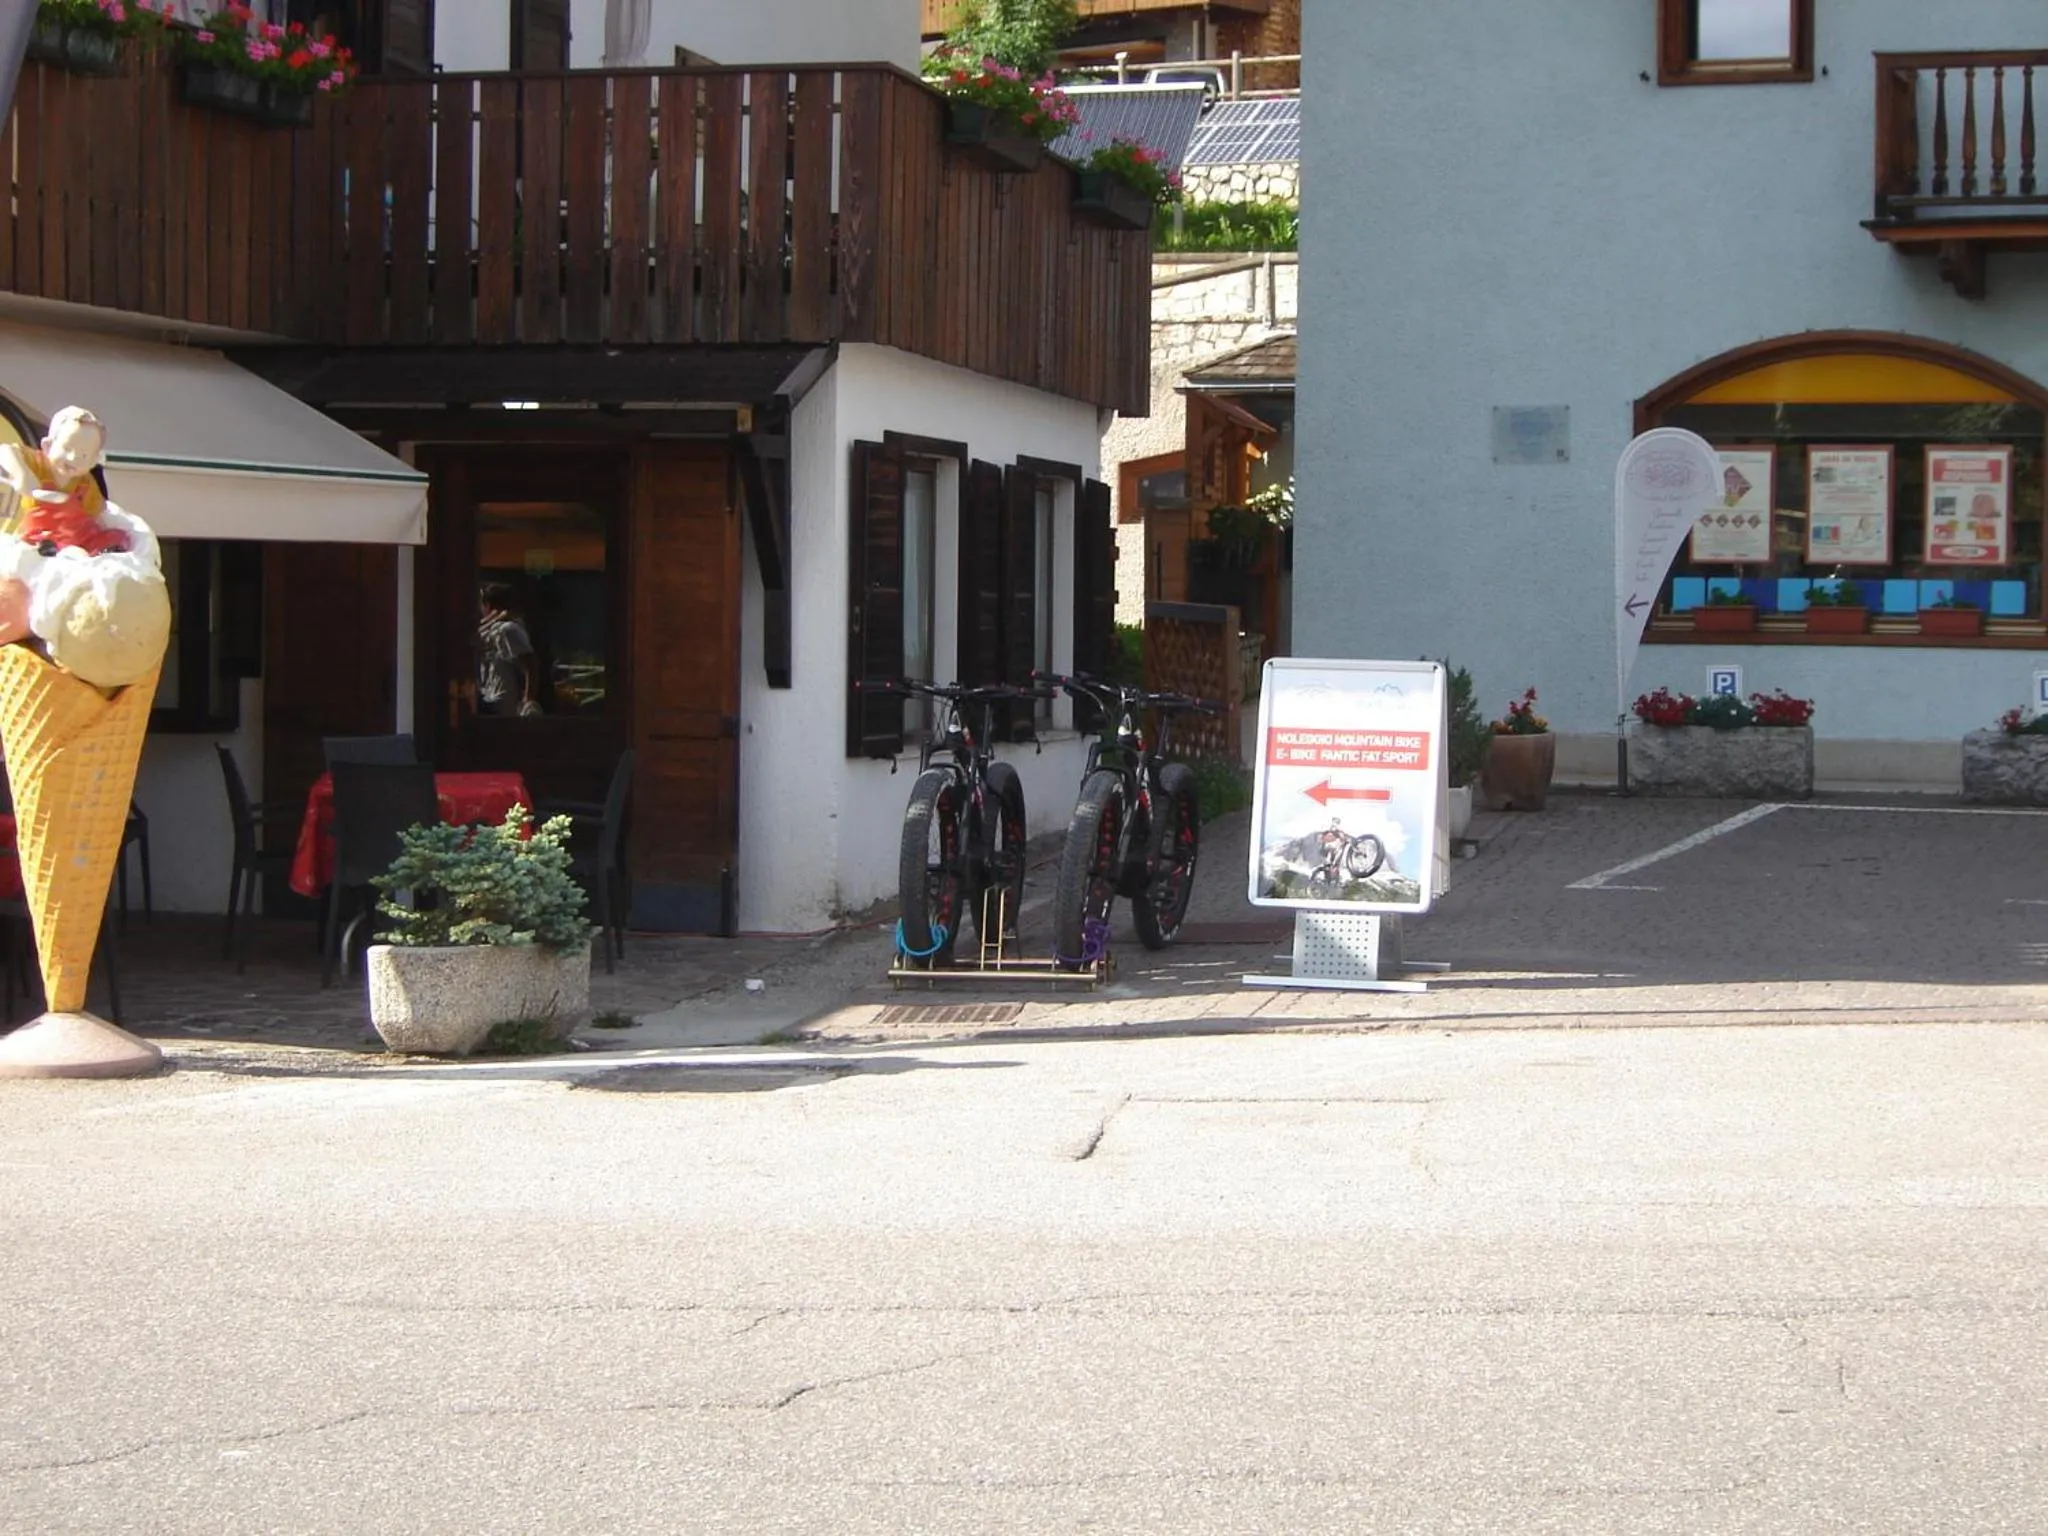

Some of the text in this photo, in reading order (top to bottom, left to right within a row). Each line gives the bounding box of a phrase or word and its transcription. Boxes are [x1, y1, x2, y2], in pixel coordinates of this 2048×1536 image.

[1716, 674, 1732, 693] P
[1276, 733, 1422, 748] NOLEGGIO MOUNTAIN BIKE
[1290, 749, 1316, 761] BIKE
[1320, 750, 1360, 762] FANTIC
[1382, 752, 1420, 764] SPORT
